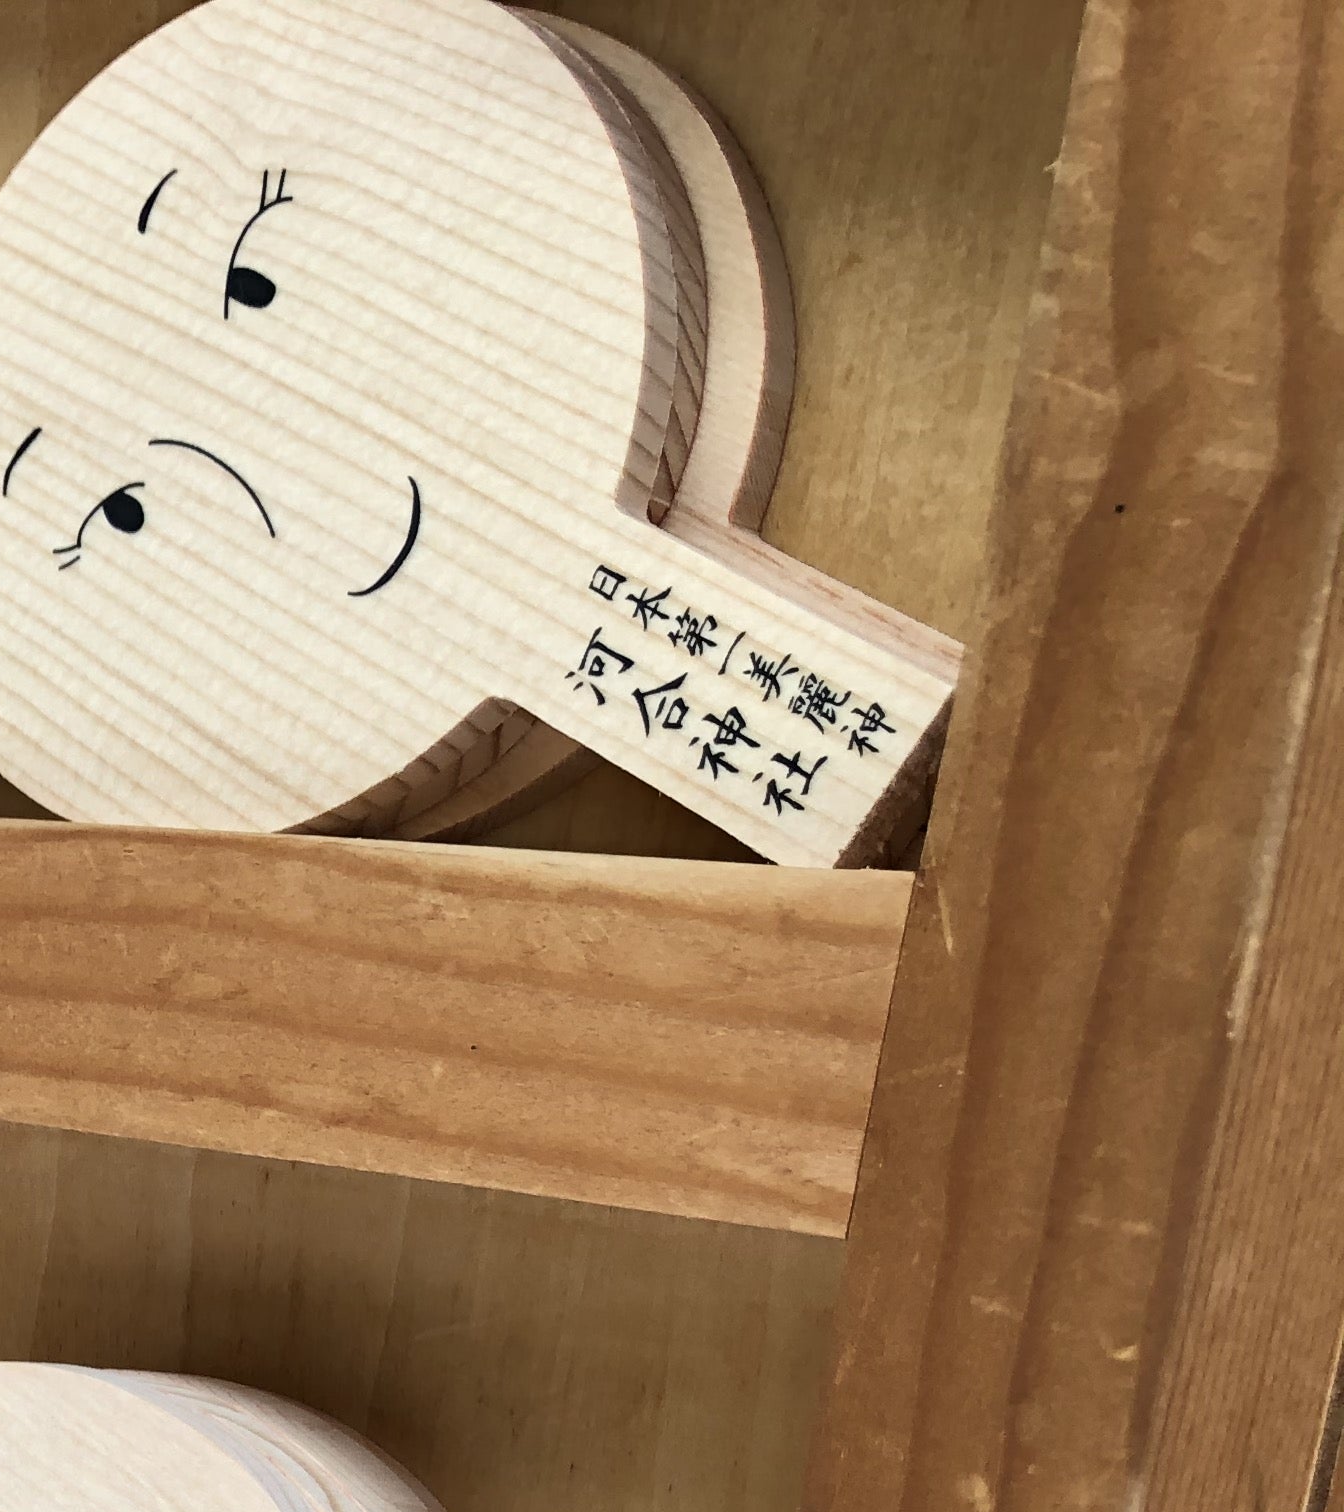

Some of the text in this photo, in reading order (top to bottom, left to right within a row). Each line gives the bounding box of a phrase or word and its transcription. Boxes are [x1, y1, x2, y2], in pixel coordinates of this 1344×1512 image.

[565, 627, 828, 816] 河合神社
[589, 564, 898, 758] 日本第一美麗神
